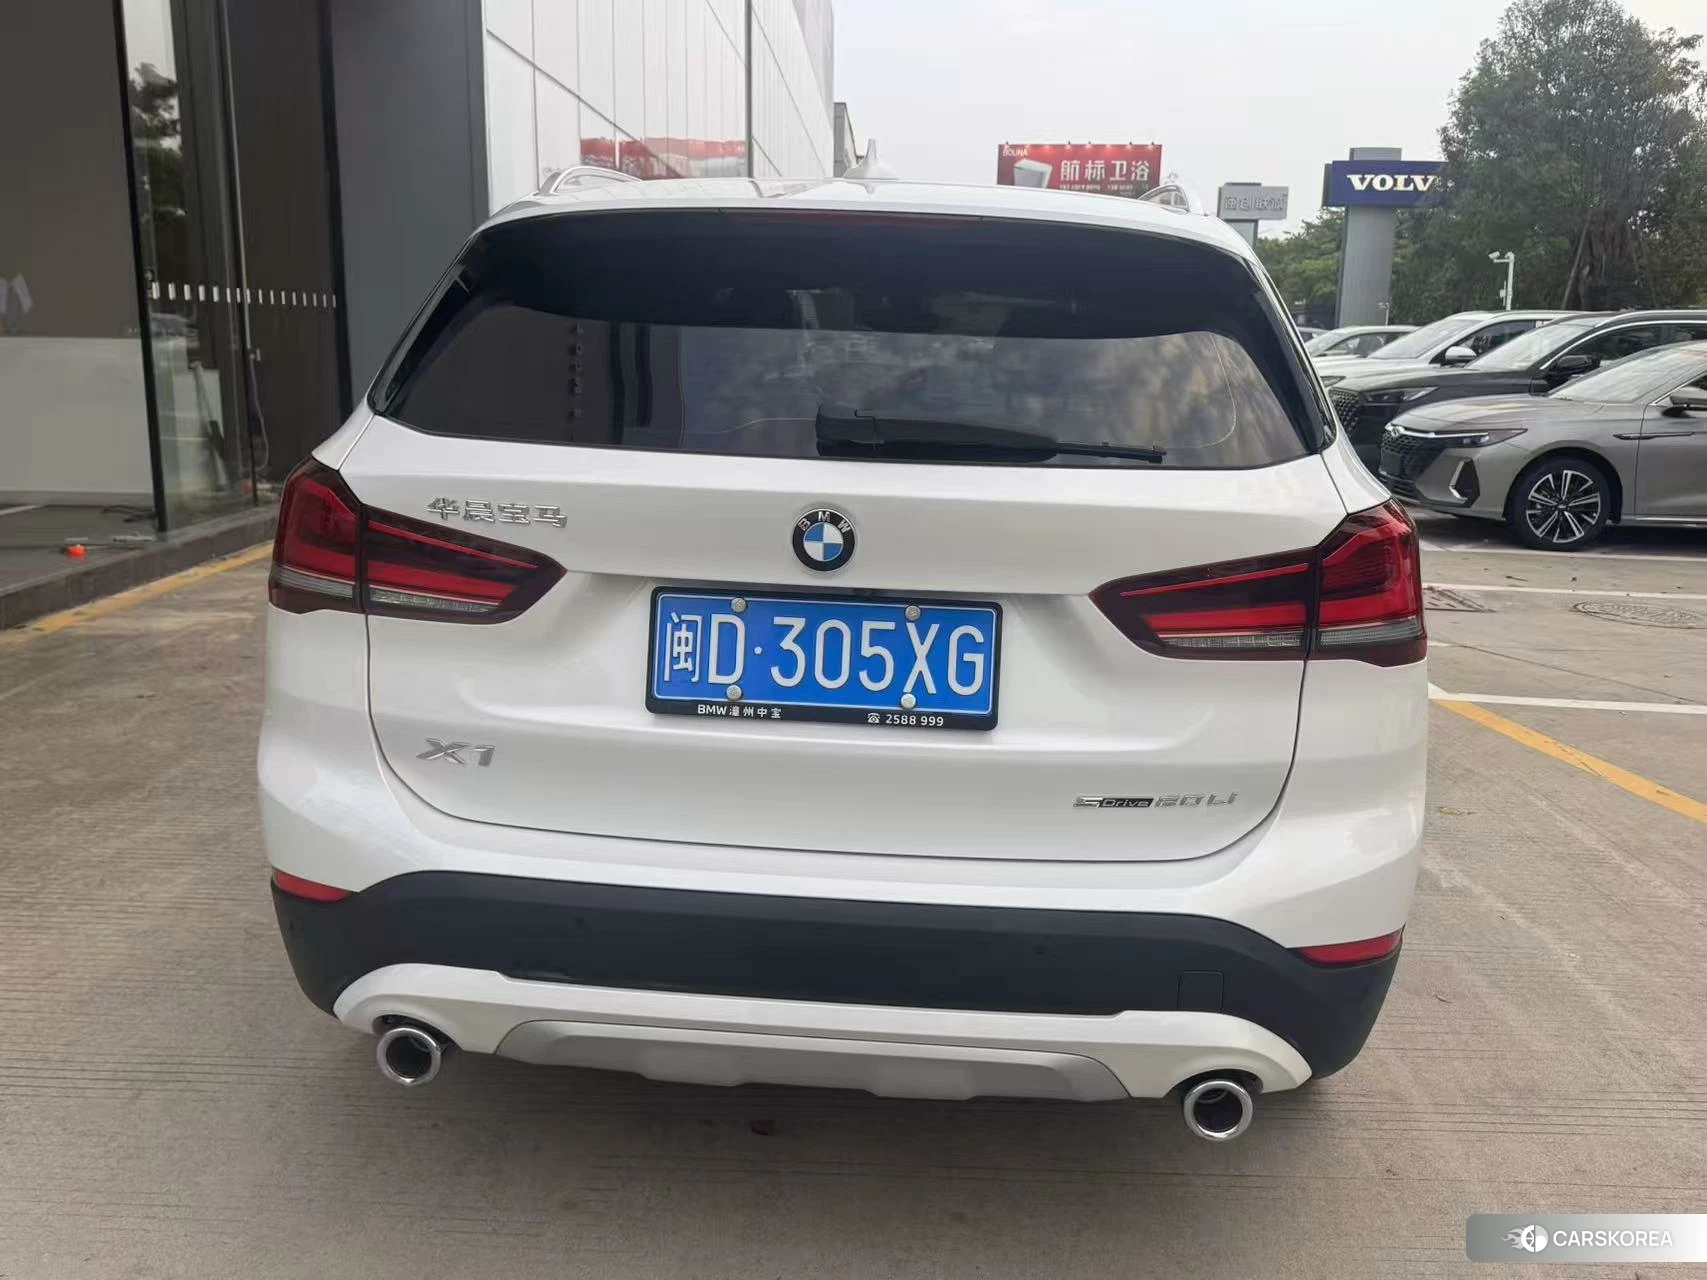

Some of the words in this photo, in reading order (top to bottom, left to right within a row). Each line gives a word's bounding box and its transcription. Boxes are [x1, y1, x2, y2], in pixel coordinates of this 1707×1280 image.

[1060, 160, 1150, 181] 航标卫浴
[426, 497, 568, 528] 华晨宝马
[798, 511, 851, 533] BMW
[697, 704, 728, 716] BMW
[885, 713, 917, 726] 2588
[920, 715, 944, 727] 999
[416, 737, 496, 766] X1
